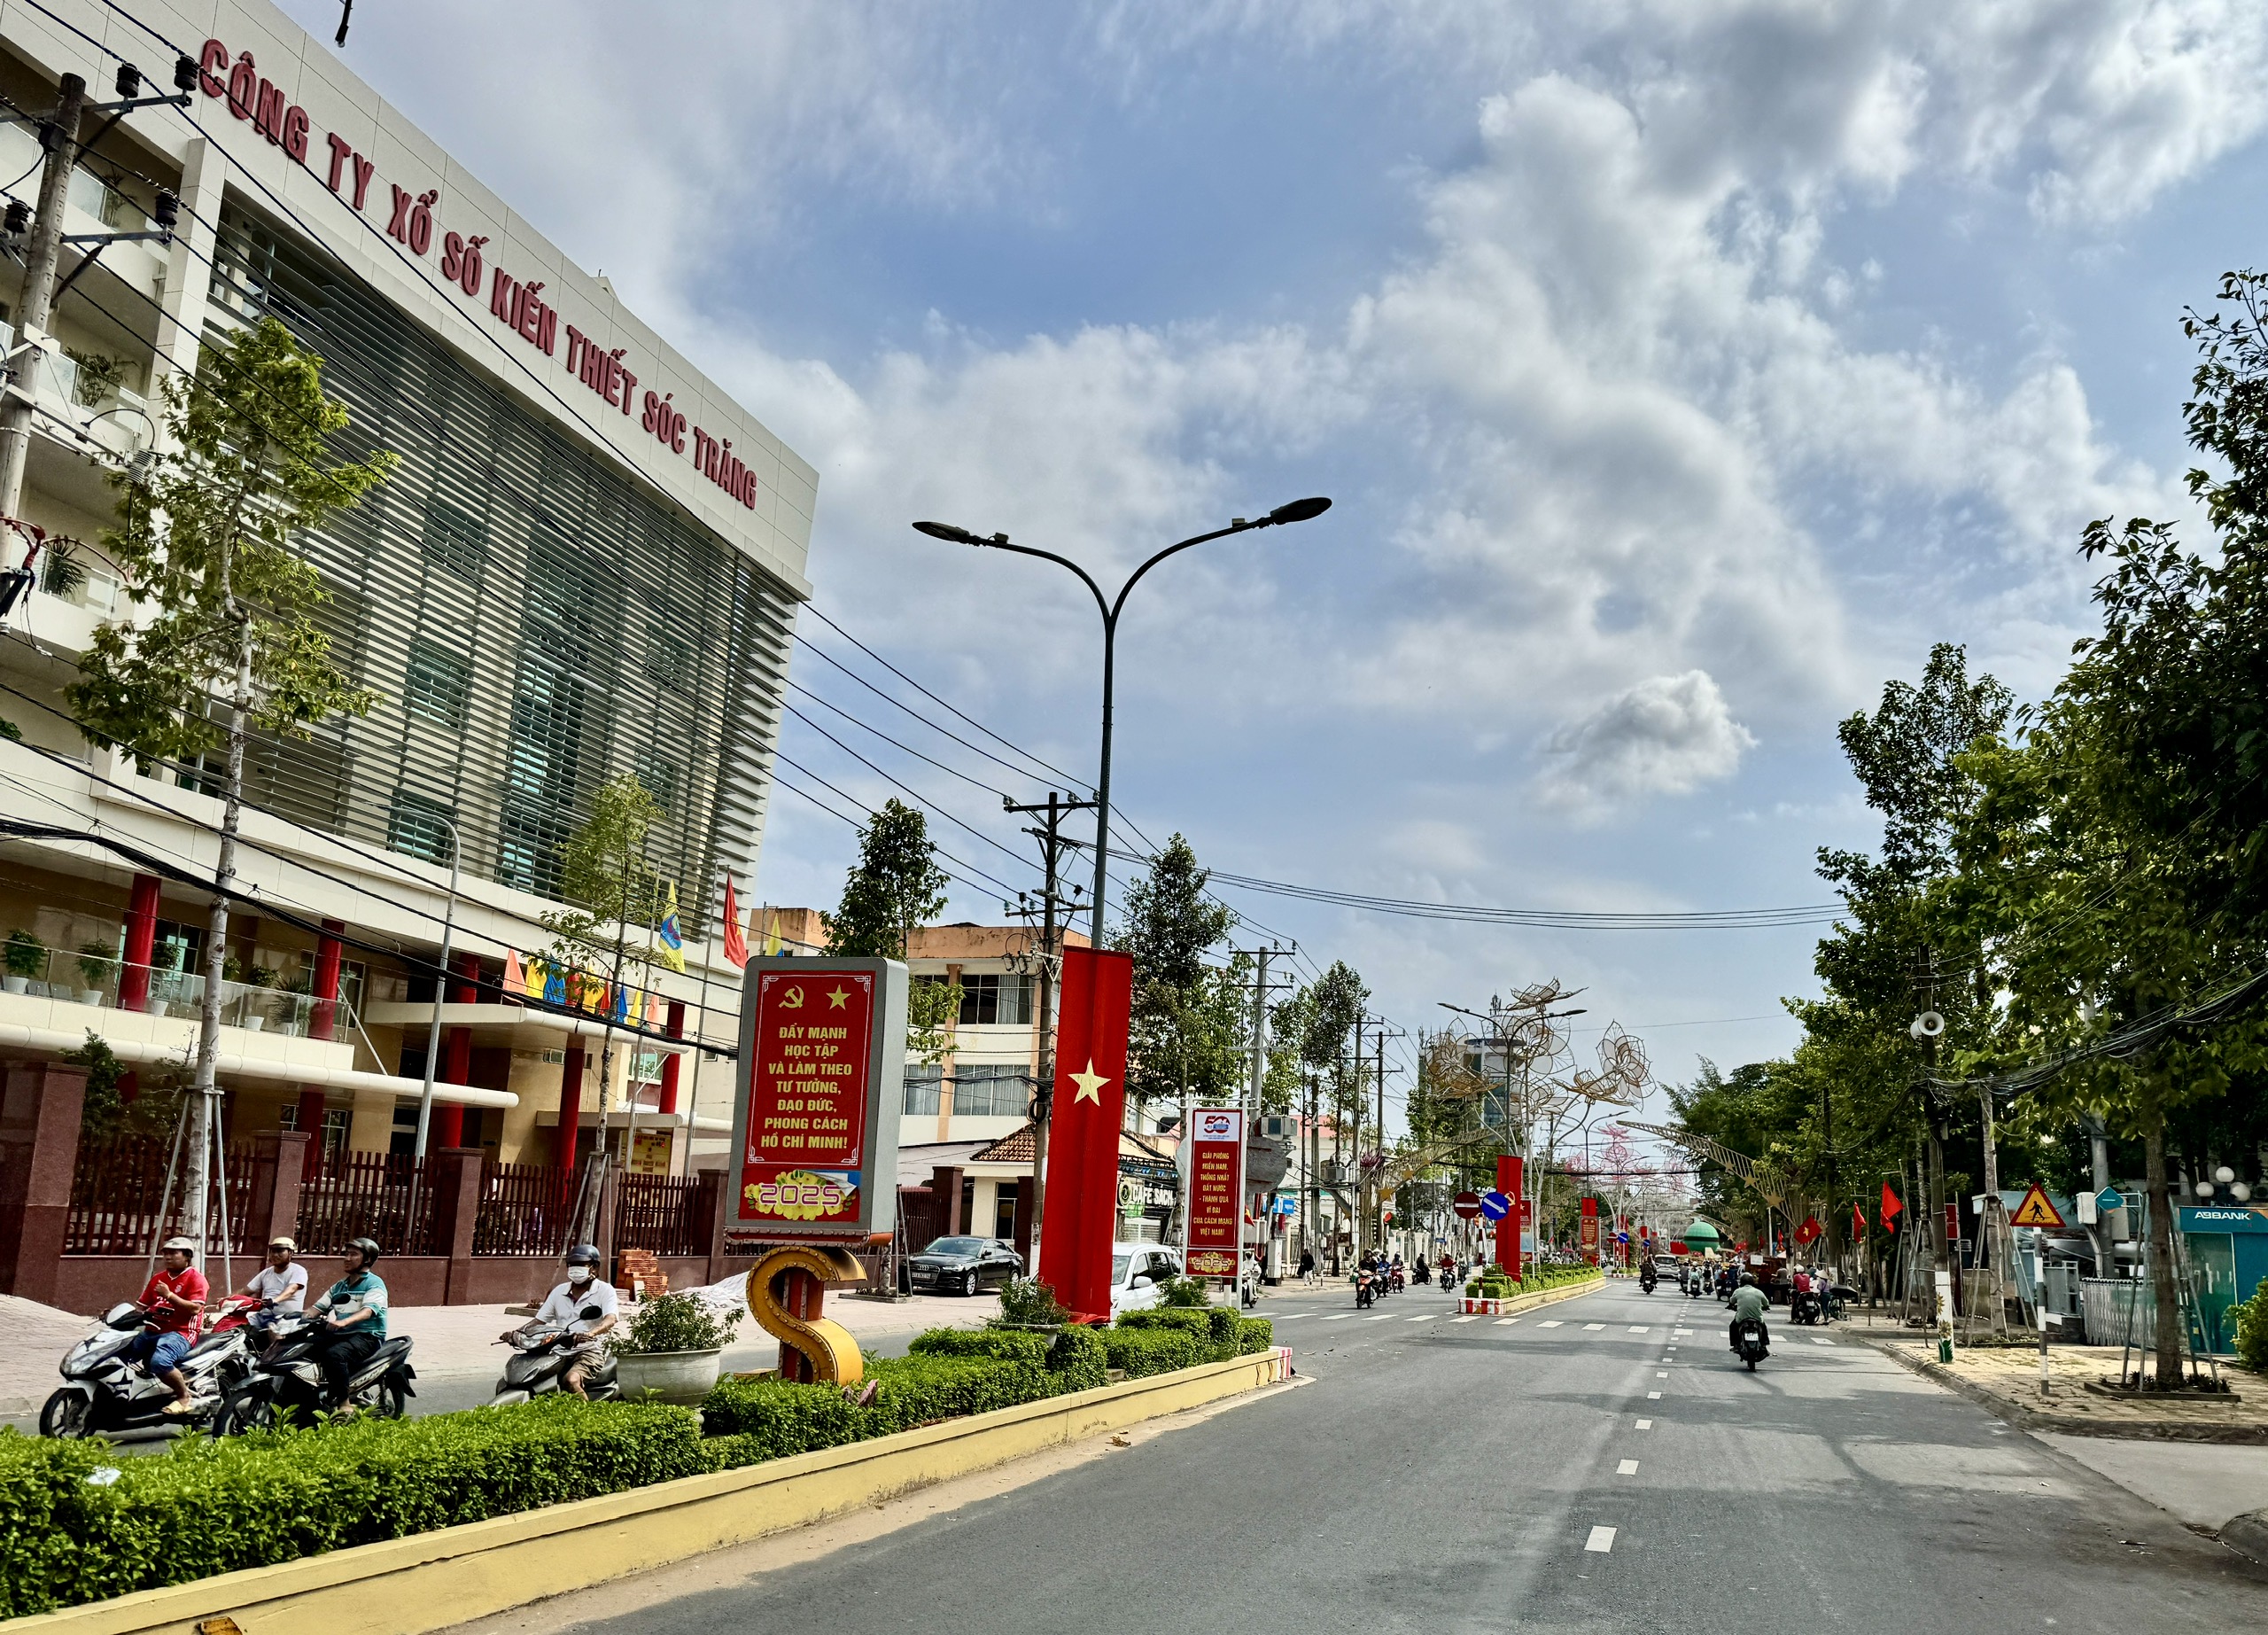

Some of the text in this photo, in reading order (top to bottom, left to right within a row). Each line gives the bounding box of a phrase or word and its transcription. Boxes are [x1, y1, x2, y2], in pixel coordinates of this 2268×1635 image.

[199, 39, 757, 510] CÔNG TY XỔ SỐ KIẾN THIẾT SÓC TRĂNG
[808, 1026, 847, 1041] MẠNH
[784, 1042, 839, 1059] HỌC TẬP
[768, 1060, 852, 1076] VÀ LÀM THEO
[776, 1078, 842, 1095] TƯ TƯỞNG,
[777, 1098, 837, 1113] ĐẠO ĐỨC,
[765, 1116, 848, 1130] PHONG CÁCH
[761, 1131, 848, 1149] HỒ CHÍ MINH!
[759, 1183, 841, 1206] 2025
[2194, 1211, 2250, 1220] ABBANK
